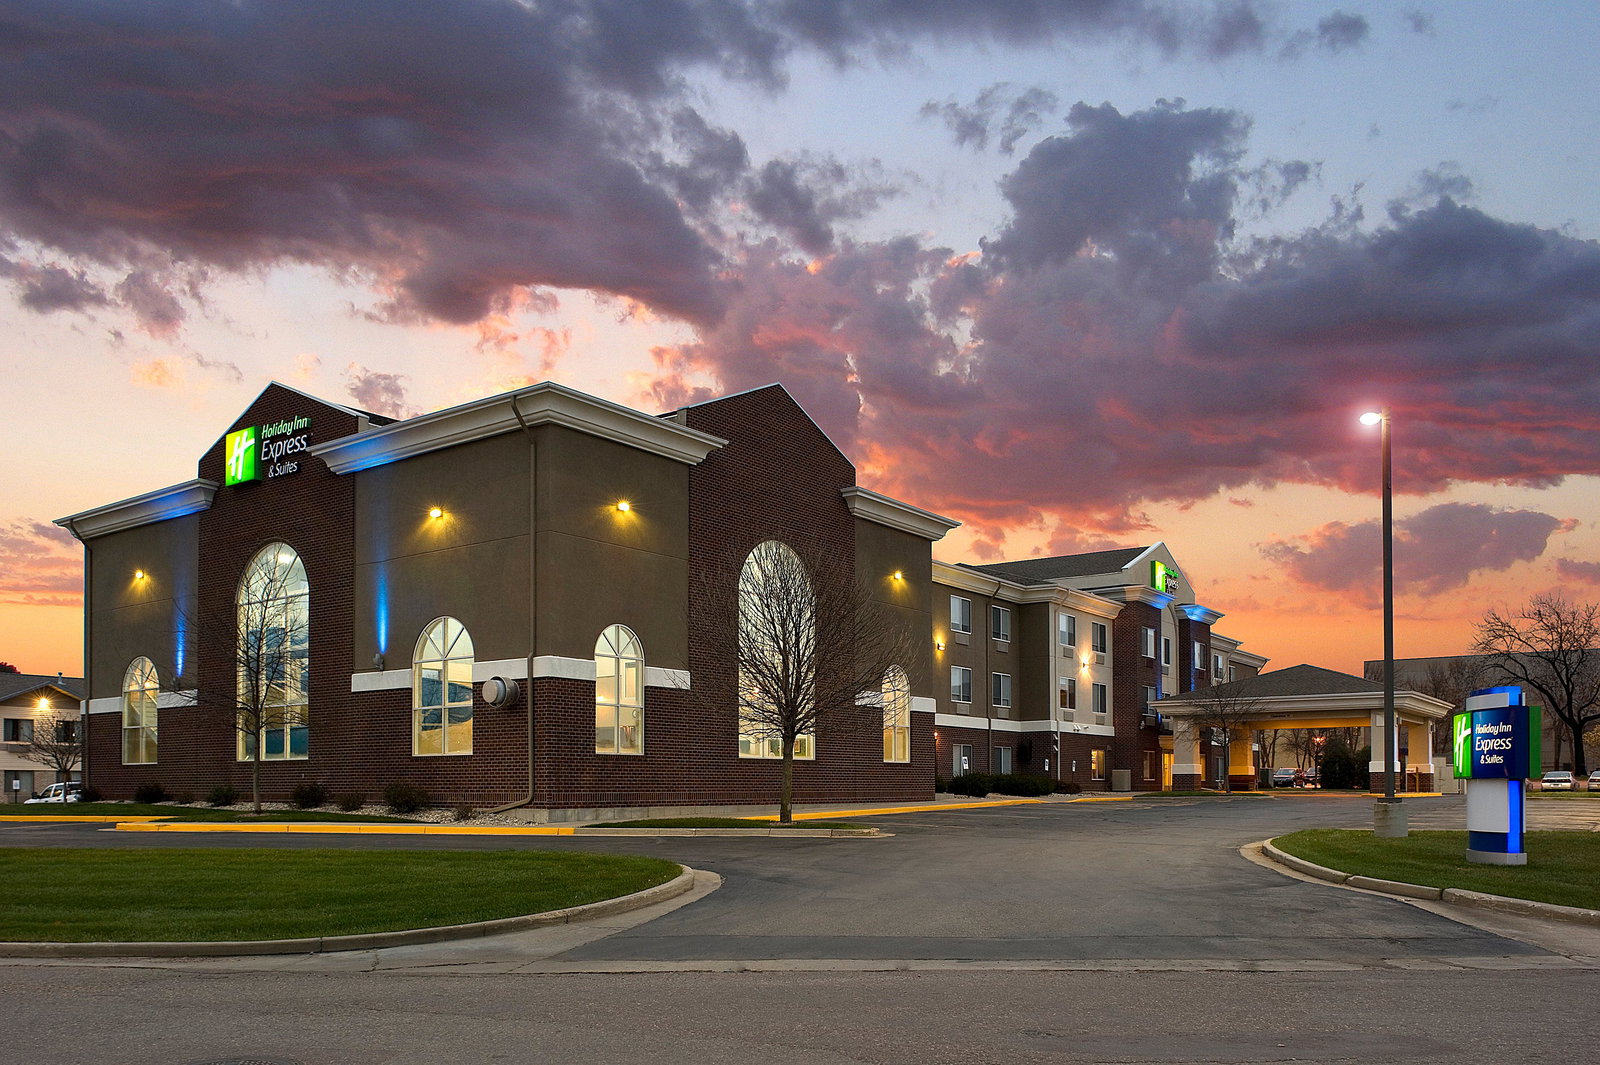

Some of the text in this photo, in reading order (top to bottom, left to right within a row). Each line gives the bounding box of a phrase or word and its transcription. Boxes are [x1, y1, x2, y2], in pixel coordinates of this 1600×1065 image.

[261, 415, 308, 439] Holiday Inn
[261, 434, 307, 463] Express
[268, 461, 298, 478] & Suites
[1475, 721, 1512, 735] Holiday Inn
[1475, 736, 1512, 754] Express
[1480, 754, 1504, 764] & Suites
